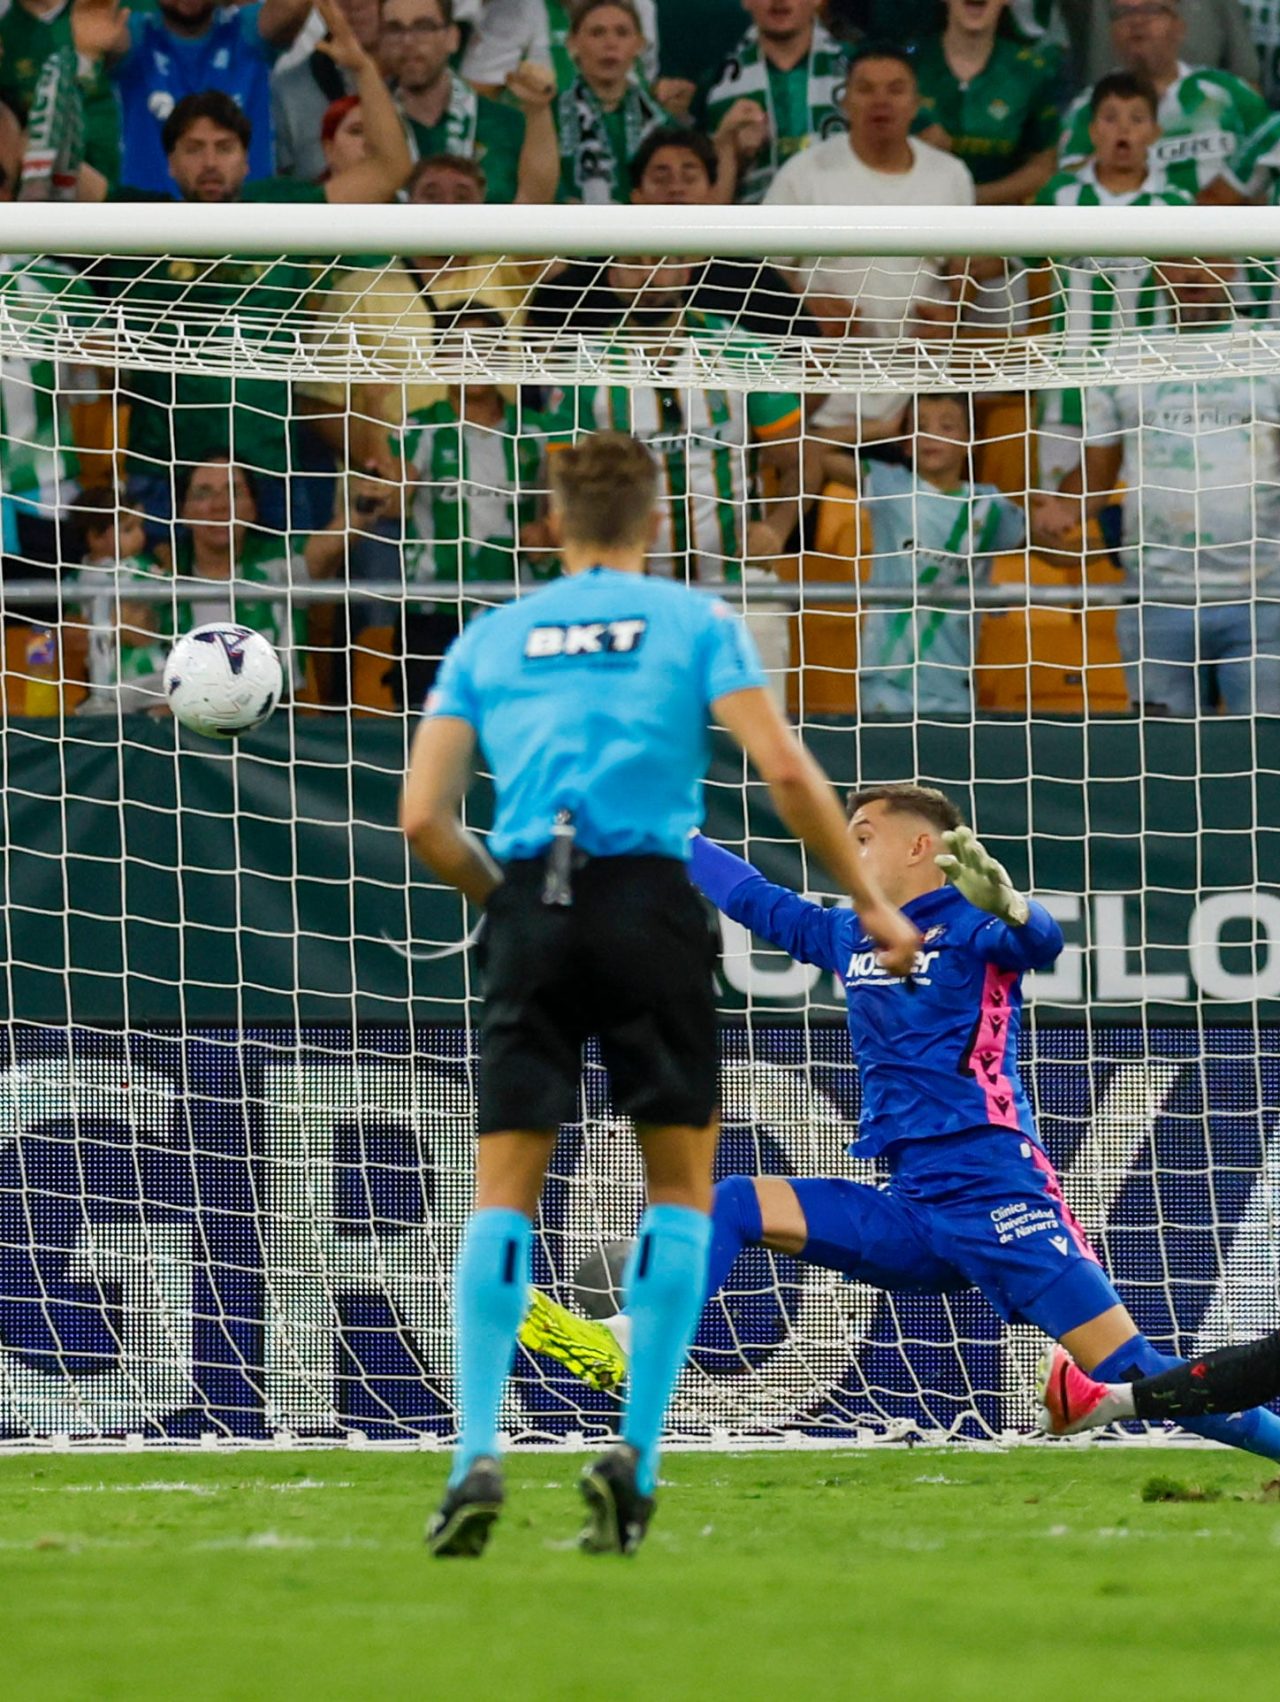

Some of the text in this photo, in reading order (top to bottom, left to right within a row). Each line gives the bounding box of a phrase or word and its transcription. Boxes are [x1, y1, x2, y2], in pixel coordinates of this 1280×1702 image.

[525, 618, 647, 658] BKT
[995, 1208, 1056, 1234] Universidad
[999, 1219, 1059, 1244] de Navarra
